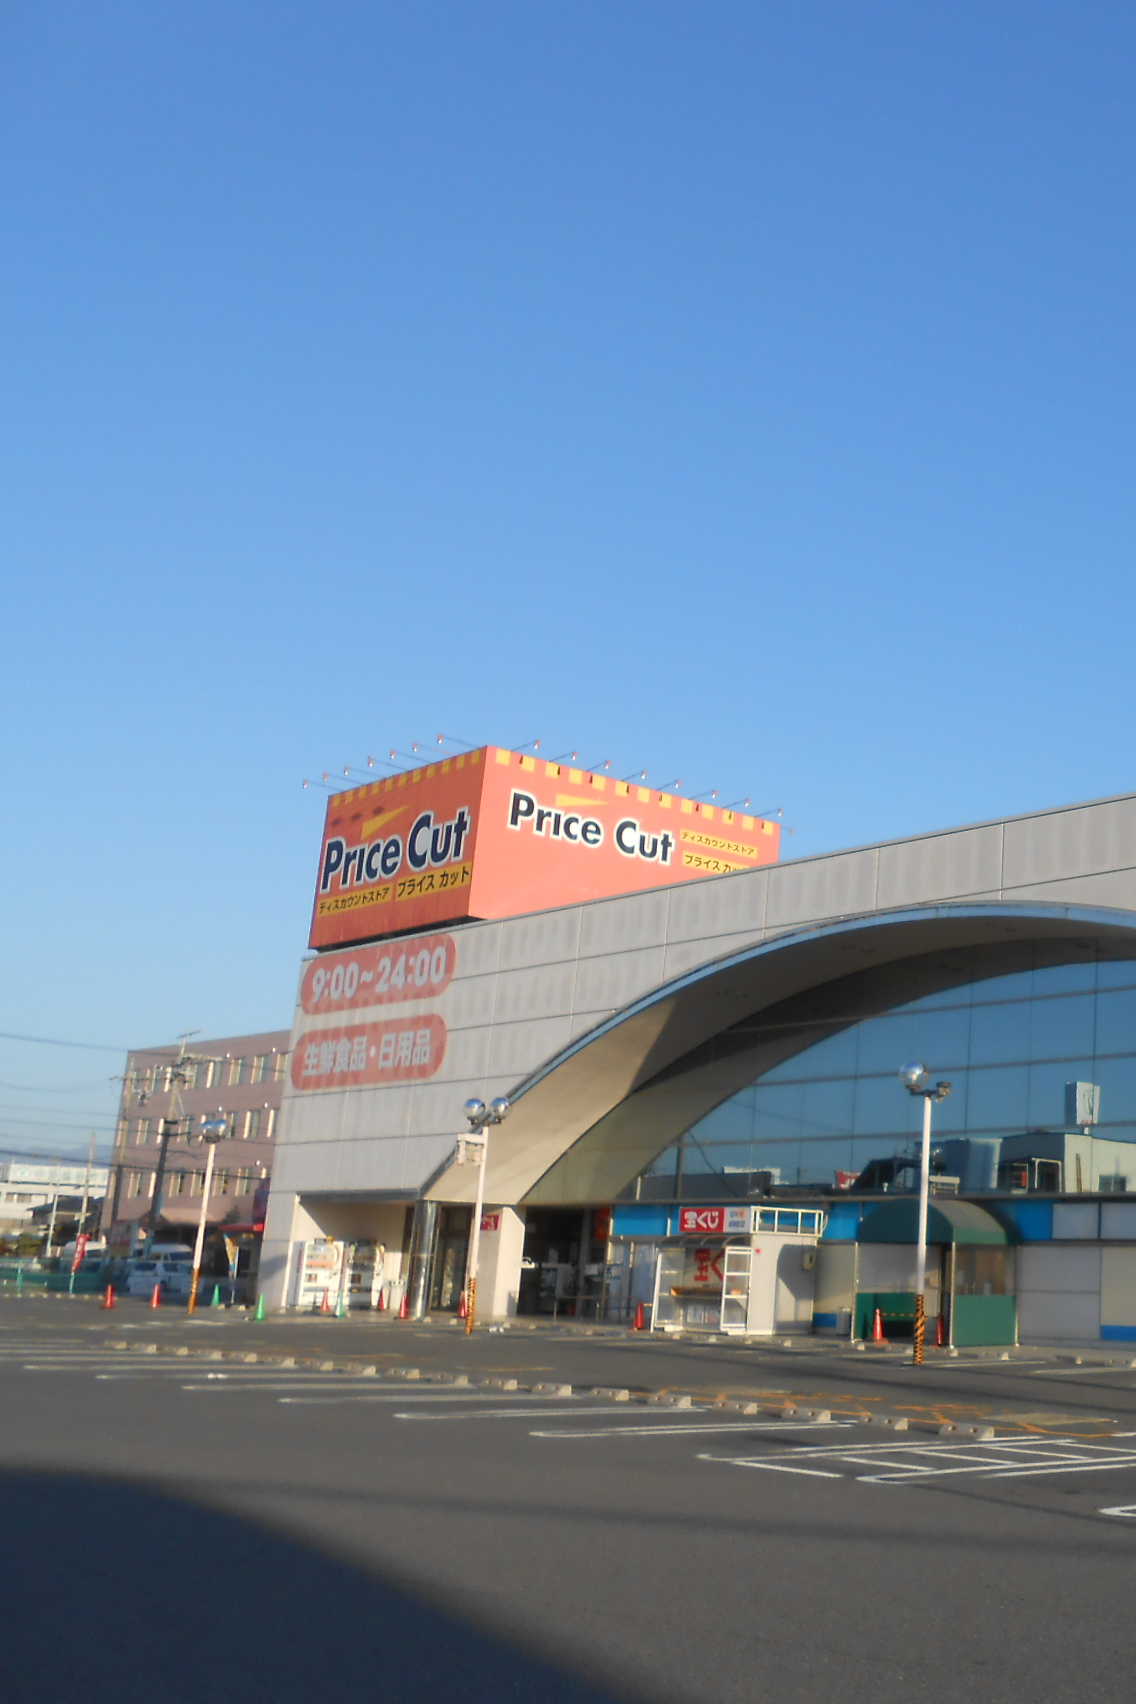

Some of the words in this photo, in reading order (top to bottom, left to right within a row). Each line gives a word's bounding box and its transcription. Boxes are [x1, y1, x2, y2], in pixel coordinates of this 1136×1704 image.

[320, 836, 402, 893] Price
[407, 808, 469, 870] Cut
[509, 790, 603, 847] Price
[614, 819, 674, 864] Cut
[681, 831, 755, 856] ディスカウントストア
[318, 887, 390, 914] ディスカウントストア
[438, 865, 470, 889] カット
[684, 1211, 719, 1229] 宝くじ
